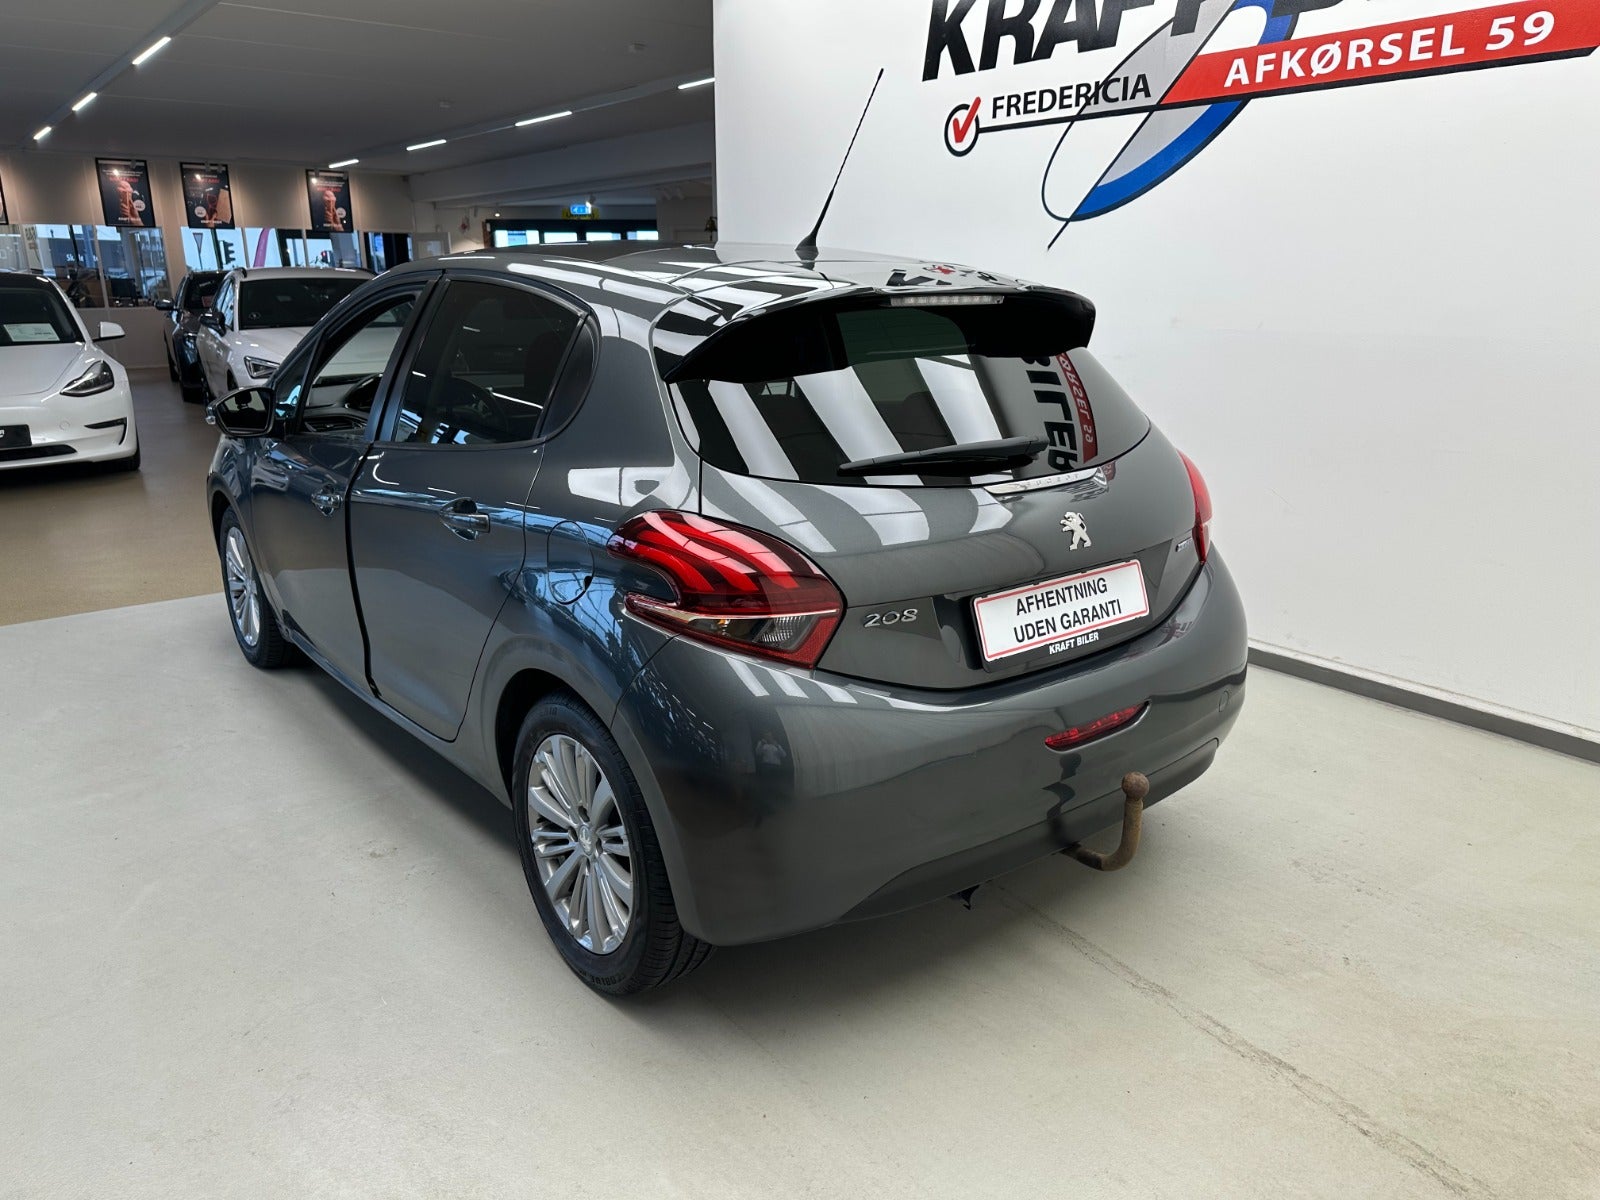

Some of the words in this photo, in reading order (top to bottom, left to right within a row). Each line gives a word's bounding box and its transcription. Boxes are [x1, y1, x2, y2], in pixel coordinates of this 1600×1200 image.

[1223, 24, 1464, 88] AFKØRSEL
[1485, 10, 1555, 51] 59
[992, 73, 1151, 119] FREDERICIA
[1016, 577, 1108, 616] AFHENTNING
[864, 608, 918, 628] 208
[1013, 619, 1057, 644] UDEN
[1060, 599, 1122, 631] GARANTI
[1049, 638, 1075, 655] KRAFT
[1076, 632, 1099, 649] BILER
